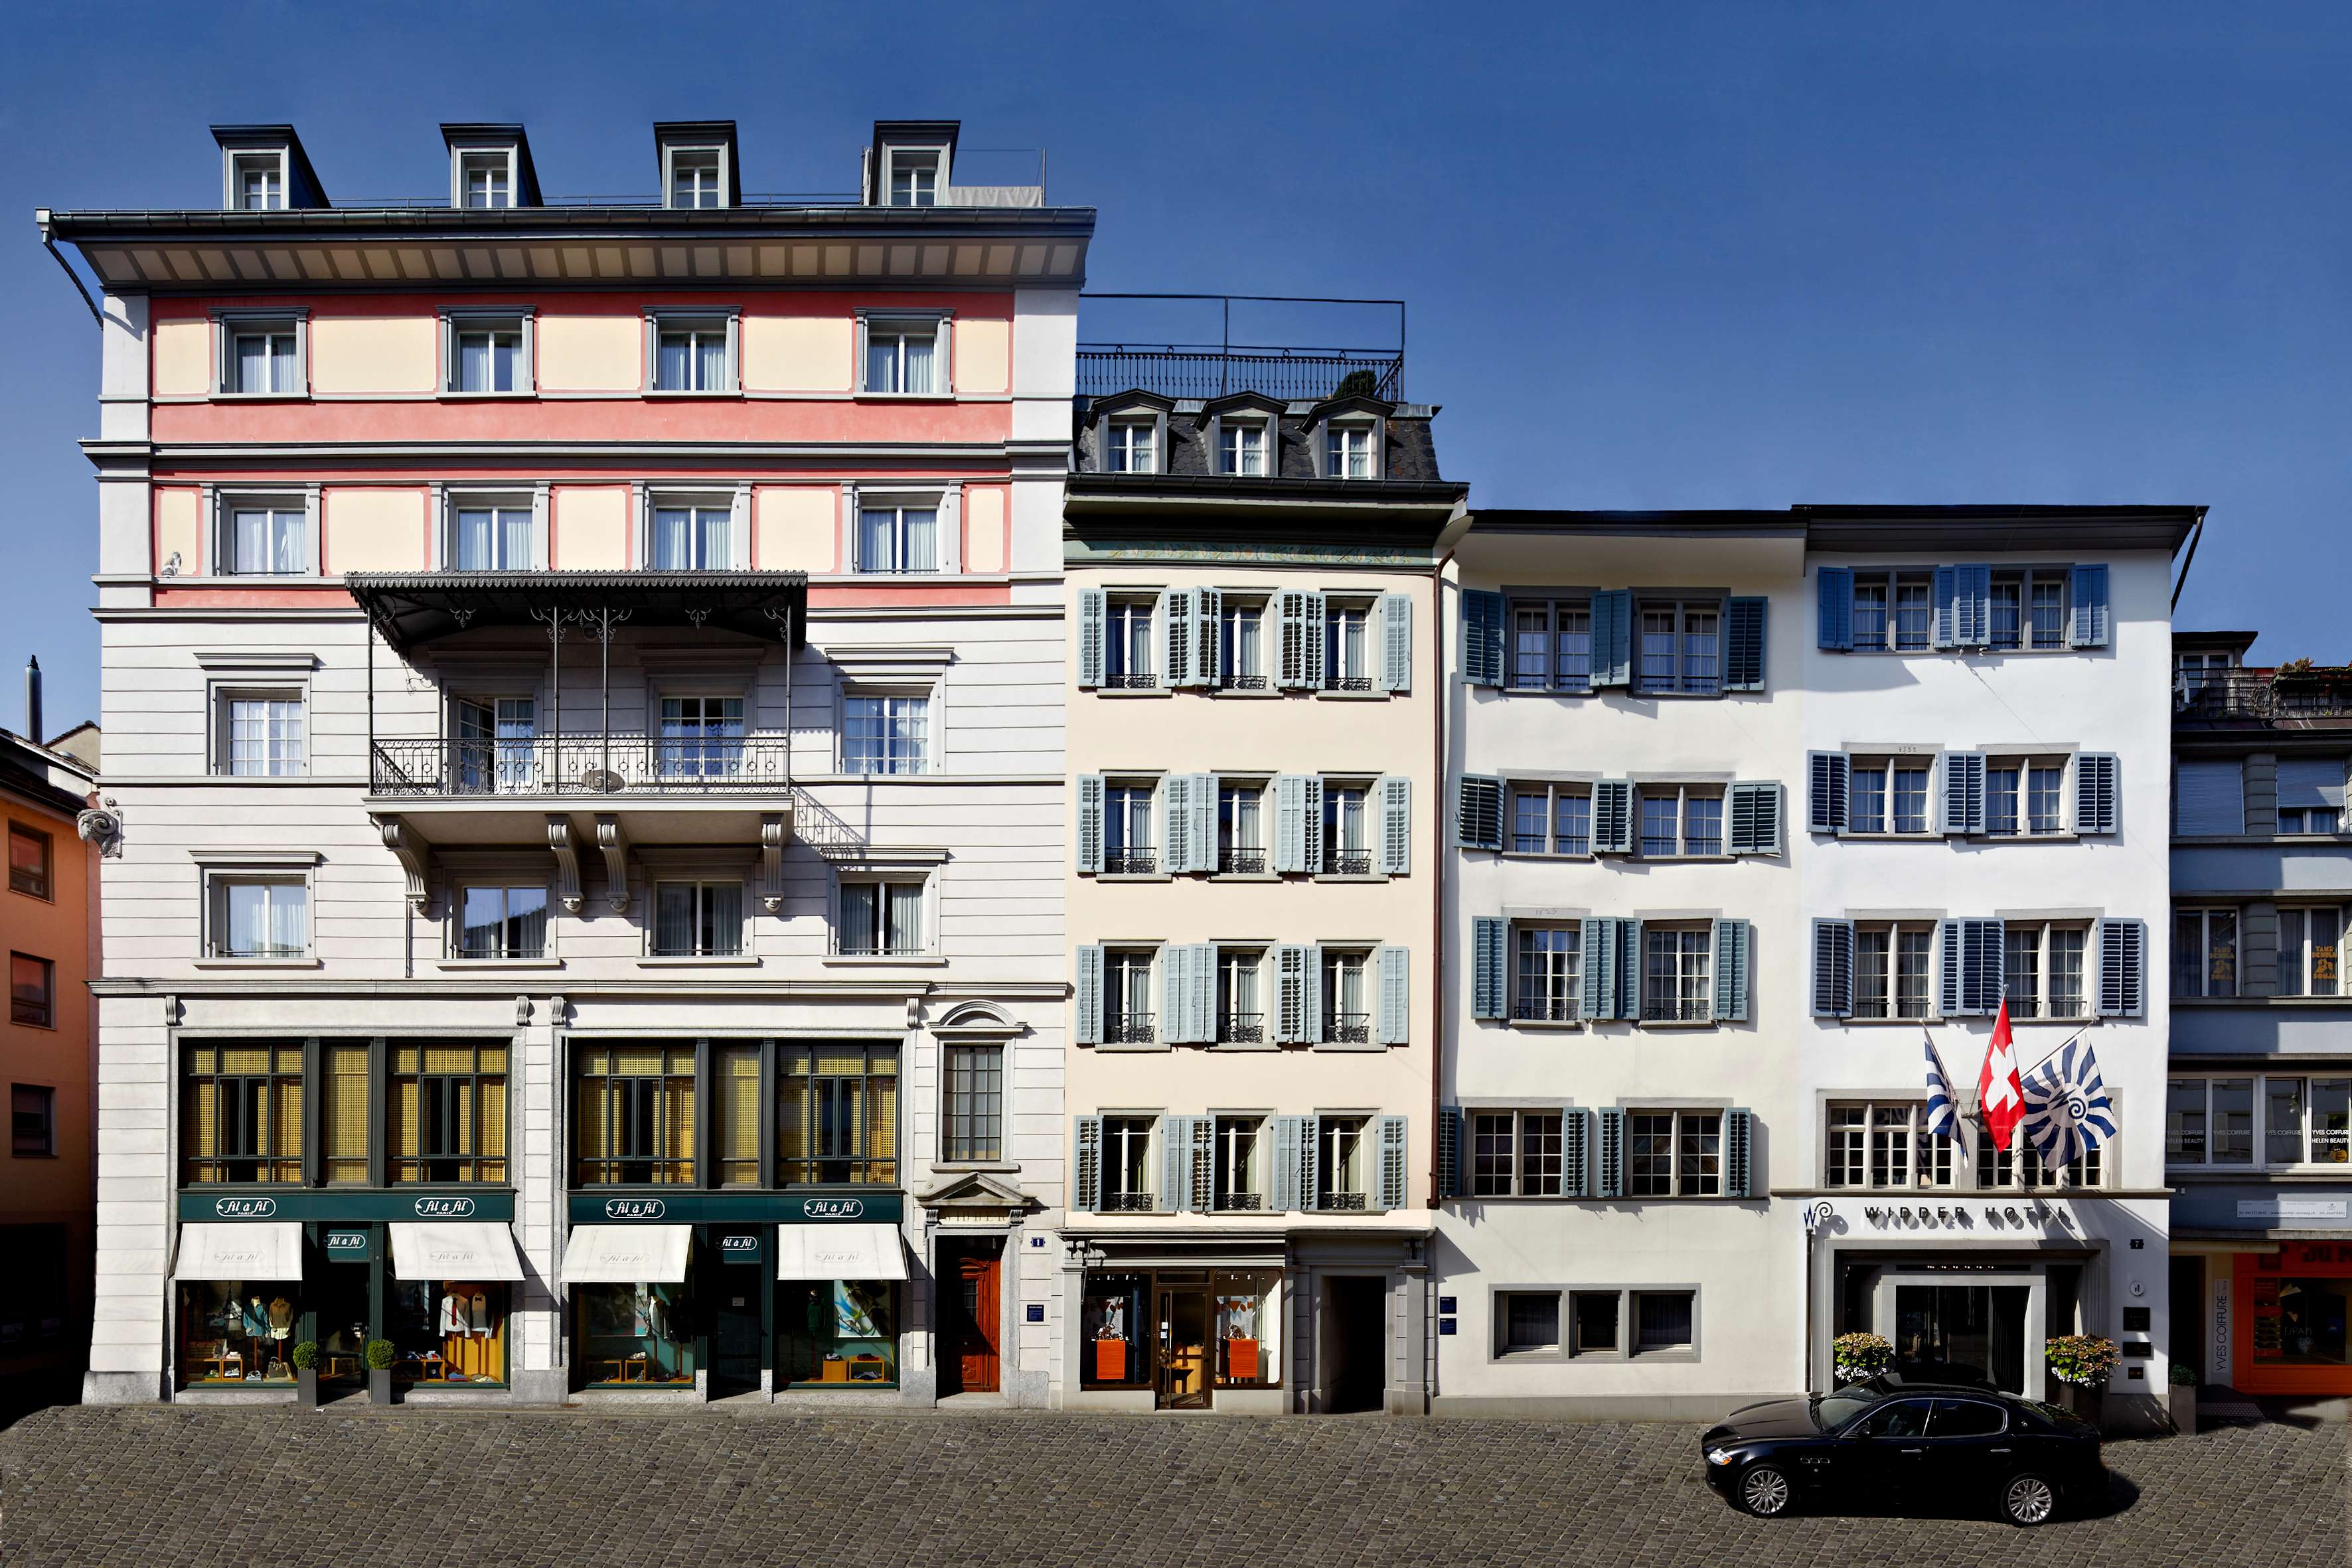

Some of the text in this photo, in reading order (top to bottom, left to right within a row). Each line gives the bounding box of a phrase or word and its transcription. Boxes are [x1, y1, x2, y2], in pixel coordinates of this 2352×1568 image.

[224, 1200, 240, 1214] fil
[252, 1200, 268, 1213] fil
[423, 1200, 439, 1213] fil
[450, 1200, 466, 1213] fil
[614, 1202, 629, 1215] fil
[641, 1202, 656, 1214] fil
[812, 1202, 828, 1214] fil
[839, 1202, 854, 1214] fil
[1864, 1206, 2066, 1219] WIDDER HOTEL
[942, 1210, 1008, 1221] WIDDER
[328, 1236, 341, 1246] fil
[348, 1236, 360, 1246] fil
[722, 1238, 732, 1247] fil
[740, 1238, 752, 1248] fil
[2216, 1295, 2227, 1343] COIFFURE
[2216, 1346, 2227, 1371] YVES
